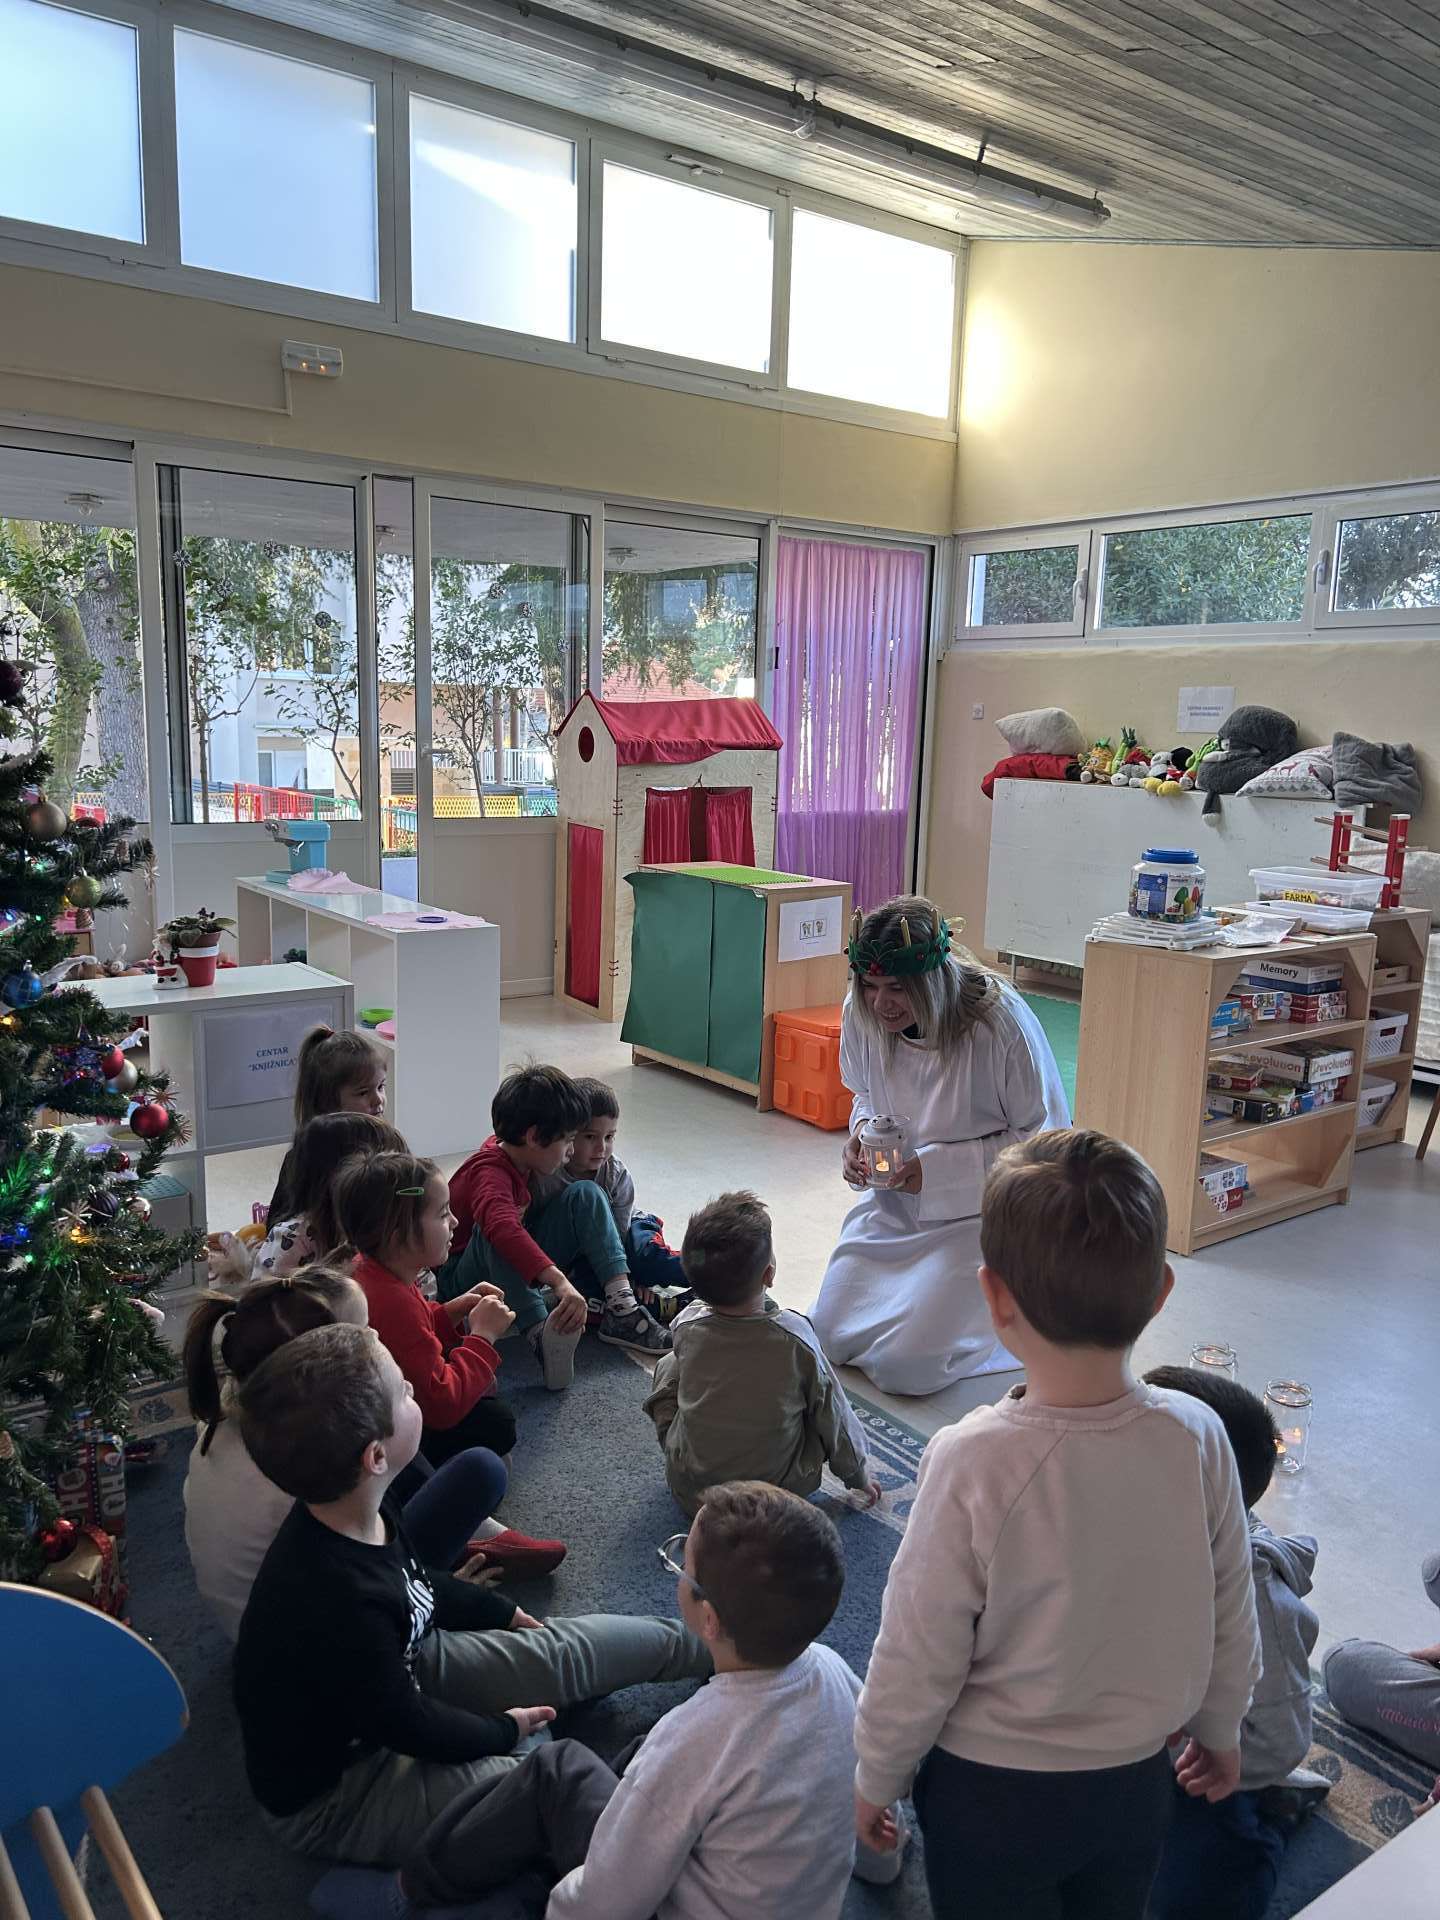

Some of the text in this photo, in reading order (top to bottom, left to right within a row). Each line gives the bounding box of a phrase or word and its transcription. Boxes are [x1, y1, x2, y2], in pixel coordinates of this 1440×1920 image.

[1284, 892, 1313, 904] FARMA
[1260, 962, 1299, 979] Memory
[256, 1046, 289, 1057] CENTAR
